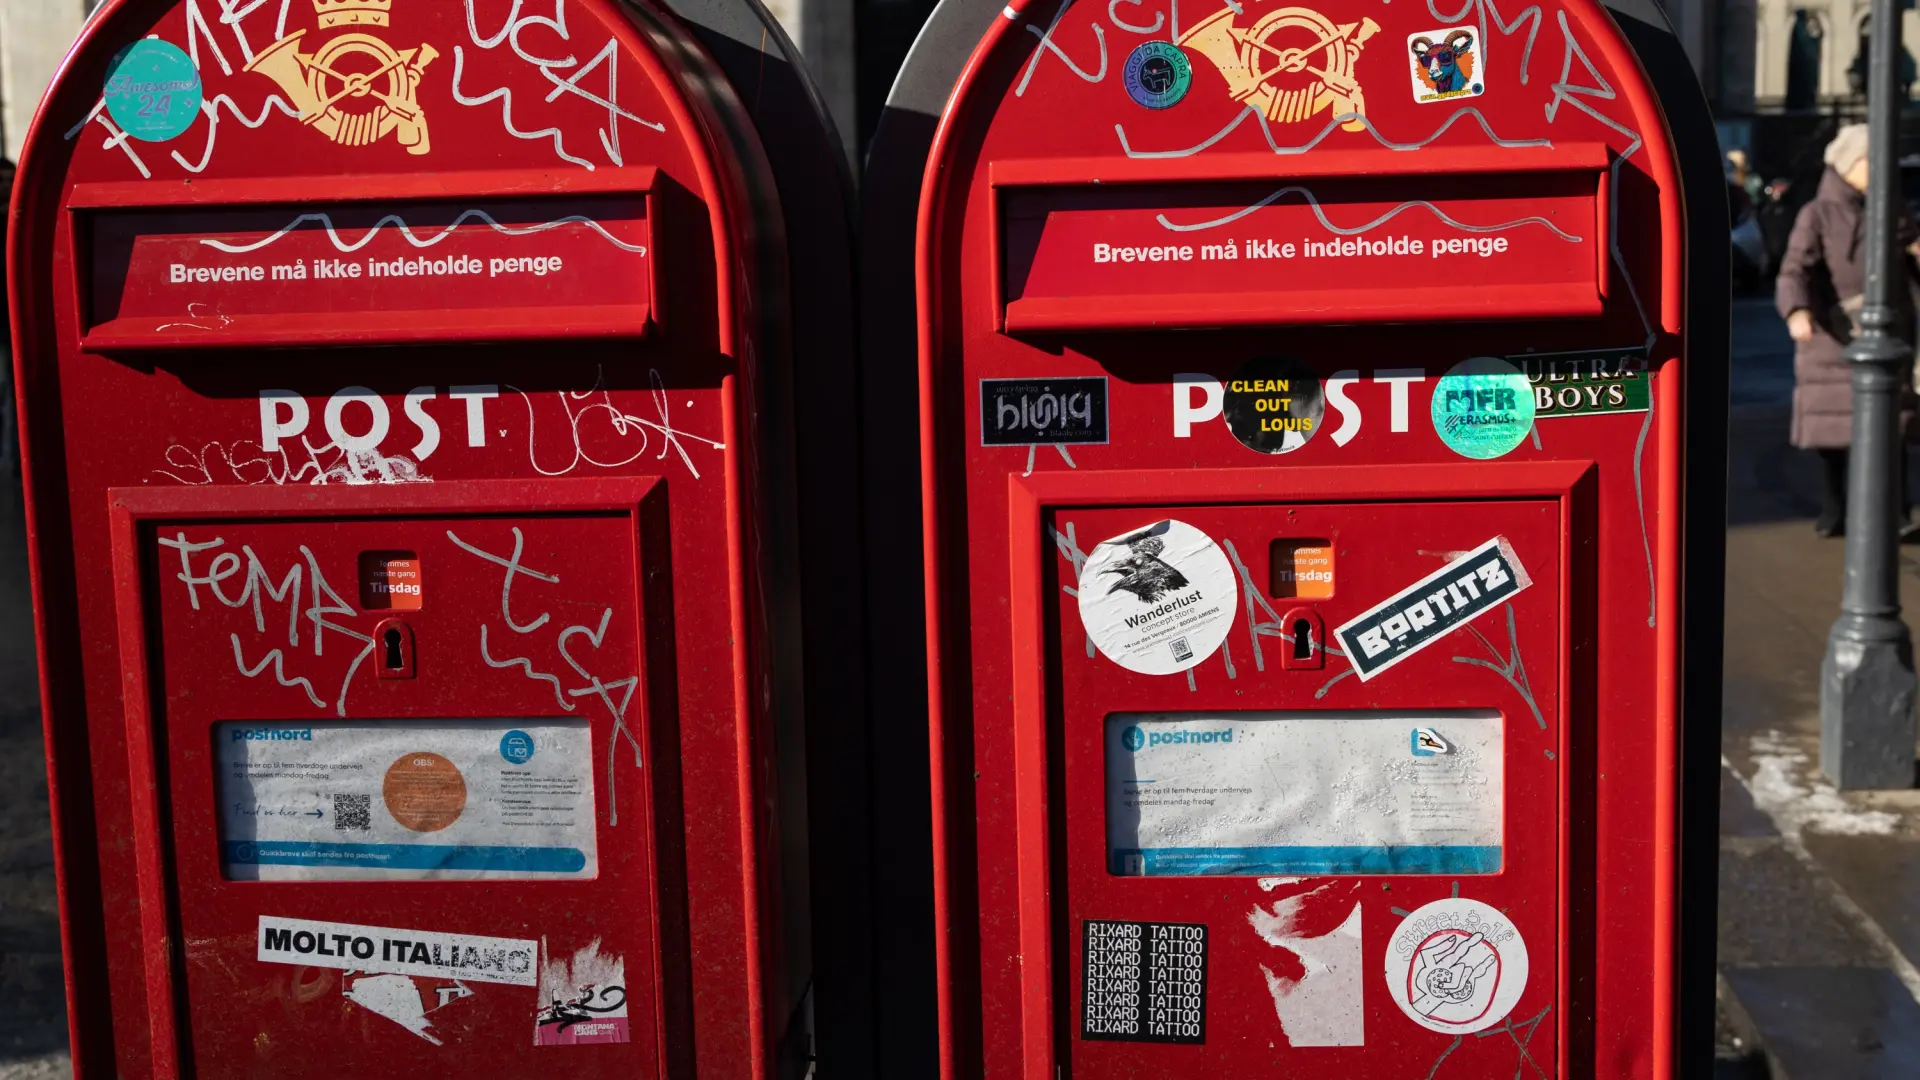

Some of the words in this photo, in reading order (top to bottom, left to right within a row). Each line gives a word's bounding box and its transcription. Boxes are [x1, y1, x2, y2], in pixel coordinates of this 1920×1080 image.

[1127, 53, 1143, 92] VIAGGI
[1145, 45, 1160, 56] DA
[1164, 47, 1187, 79] CAPRA
[137, 94, 172, 118] 24
[1093, 241, 1194, 264] Brevene
[1200, 238, 1238, 261] må
[1244, 238, 1295, 260] ikke
[1303, 234, 1424, 258] indeholde
[1431, 234, 1508, 259] penge
[170, 263, 264, 283] Brevene
[271, 258, 306, 281] må
[314, 258, 361, 279] ikke
[369, 255, 483, 278] indeholde
[490, 255, 562, 277] penge
[1522, 358, 1636, 382] ULTRA
[1231, 379, 1289, 393] CLEAN
[1255, 398, 1291, 412] OUT
[1445, 388, 1516, 413] MFR
[1535, 384, 1624, 410] BOYS
[1173, 368, 1425, 448] PST
[259, 384, 499, 461] POST
[1261, 417, 1313, 432] LOUIS
[1459, 413, 1516, 425] ERASMUS+
[1308, 558, 1328, 566] gang
[1280, 570, 1332, 582] Tirsdag
[370, 582, 420, 595] Tirsdag
[1124, 590, 1203, 629] Wanderlust
[1141, 616, 1174, 634] concept
[1174, 606, 1195, 620] store
[1151, 626, 1176, 639] Vergeaux
[1198, 606, 1220, 619] AMIENS
[232, 728, 312, 742] postnord
[1149, 727, 1233, 746] postnord
[273, 761, 281, 769] til
[281, 761, 295, 769] fem
[1153, 788, 1162, 796] op
[1171, 787, 1185, 795] fem
[1186, 787, 1219, 796] hverdage
[344, 851, 355, 859] fra
[1089, 923, 1141, 938] RIXARD
[1151, 926, 1203, 940] TATTOO
[1395, 912, 1460, 962] Street
[1461, 909, 1514, 948] golf
[264, 927, 375, 960] MOLTO
[382, 938, 531, 974] ITALIANO
[1089, 937, 1141, 951] RIXARD
[1150, 940, 1202, 954] TATTOO
[1089, 951, 1140, 965] RIXARD
[1150, 953, 1202, 968] TATTOO
[1088, 965, 1140, 979] RIXARD
[1149, 967, 1201, 981] TATTOO
[1088, 978, 1139, 992] RIXARD
[1149, 981, 1201, 995] TATTOO
[1088, 992, 1139, 1006] RIXARD
[1149, 995, 1200, 1009] TATTOO
[1087, 1006, 1139, 1020] RIXARD
[1148, 1008, 1200, 1022] TATTOO
[1087, 1019, 1138, 1034] RIXARD
[1148, 1022, 1199, 1036] TATTOO
